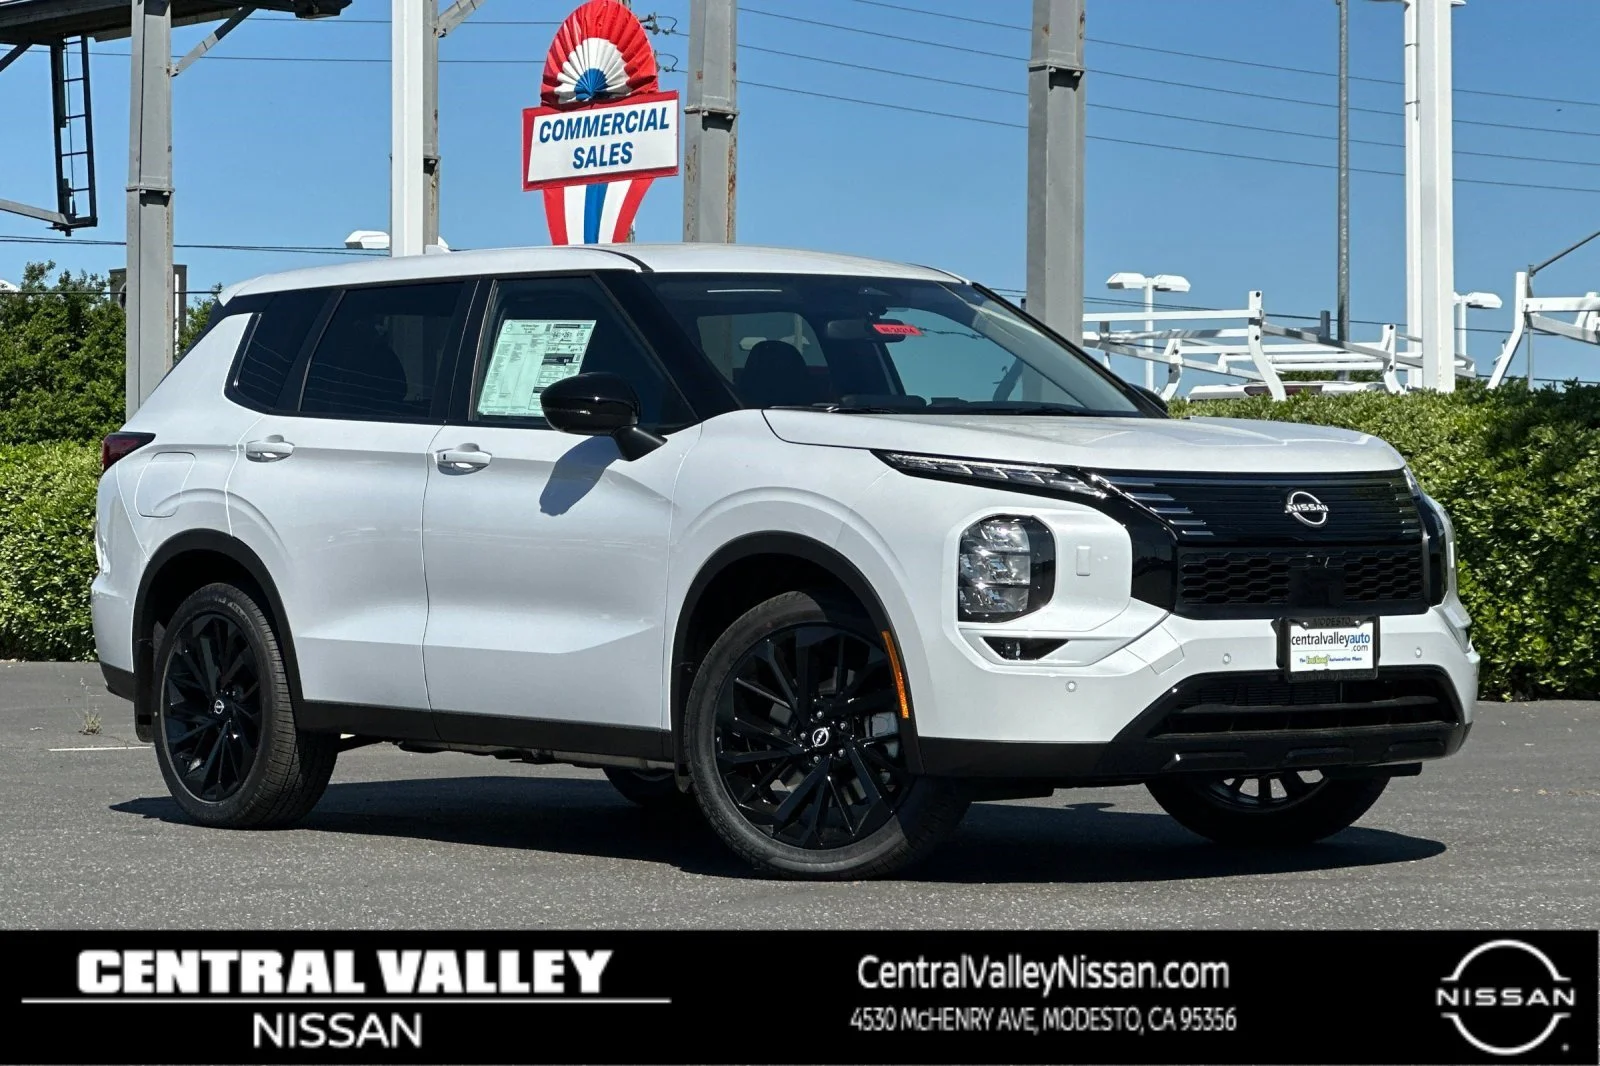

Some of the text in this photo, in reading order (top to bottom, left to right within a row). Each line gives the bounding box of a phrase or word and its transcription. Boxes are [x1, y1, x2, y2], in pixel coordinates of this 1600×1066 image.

[539, 106, 670, 144] COMMERCIAL
[572, 141, 634, 169] SALES
[1285, 503, 1329, 512] NISSAN
[1314, 616, 1351, 627] MODESTO
[1292, 632, 1371, 647] centralvalleyauto
[1350, 644, 1369, 653] .com
